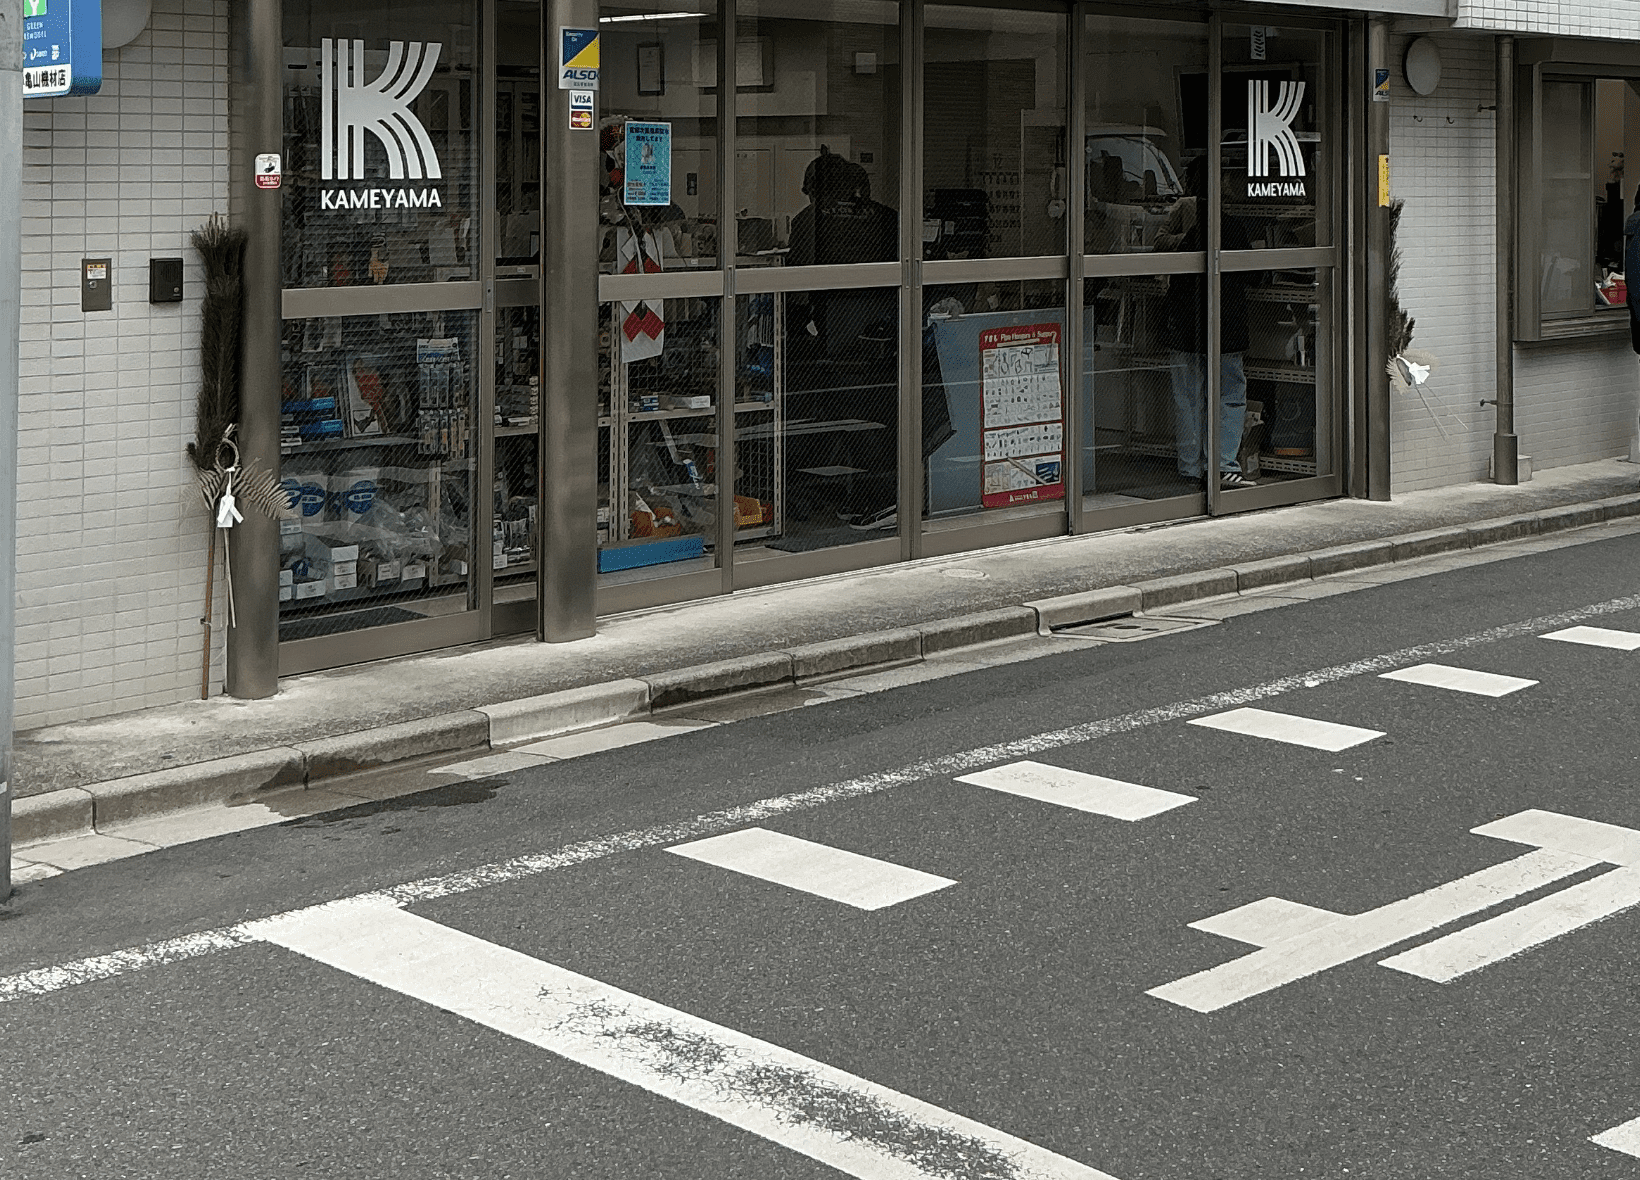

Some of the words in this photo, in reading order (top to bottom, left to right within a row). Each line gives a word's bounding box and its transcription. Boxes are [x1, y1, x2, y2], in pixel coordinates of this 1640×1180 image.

[563, 70, 600, 80] ALSO
[574, 95, 592, 104] VISA
[1247, 182, 1306, 197] KAMEYAMA
[321, 188, 442, 209] KAMEYAMA
